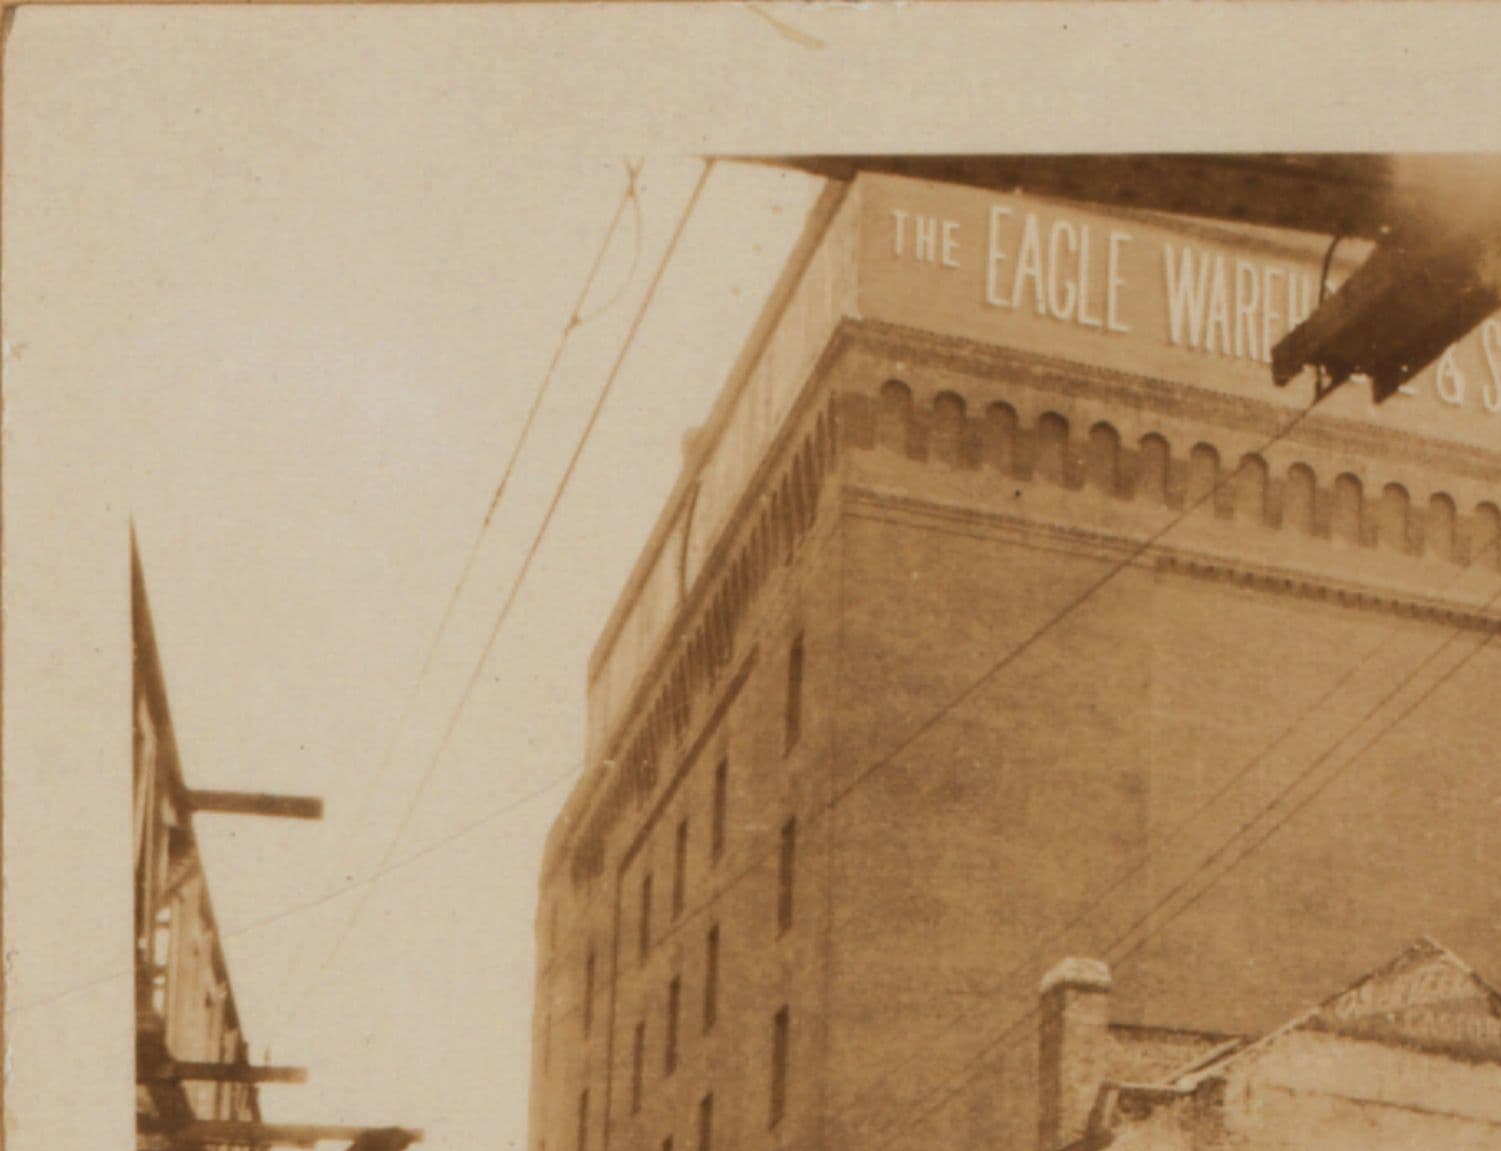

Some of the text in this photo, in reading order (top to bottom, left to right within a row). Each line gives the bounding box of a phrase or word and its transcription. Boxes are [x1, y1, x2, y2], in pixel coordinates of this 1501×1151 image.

[891, 208, 961, 269] THE
[984, 204, 1133, 334] EAGLE
[1436, 350, 1466, 408] &
